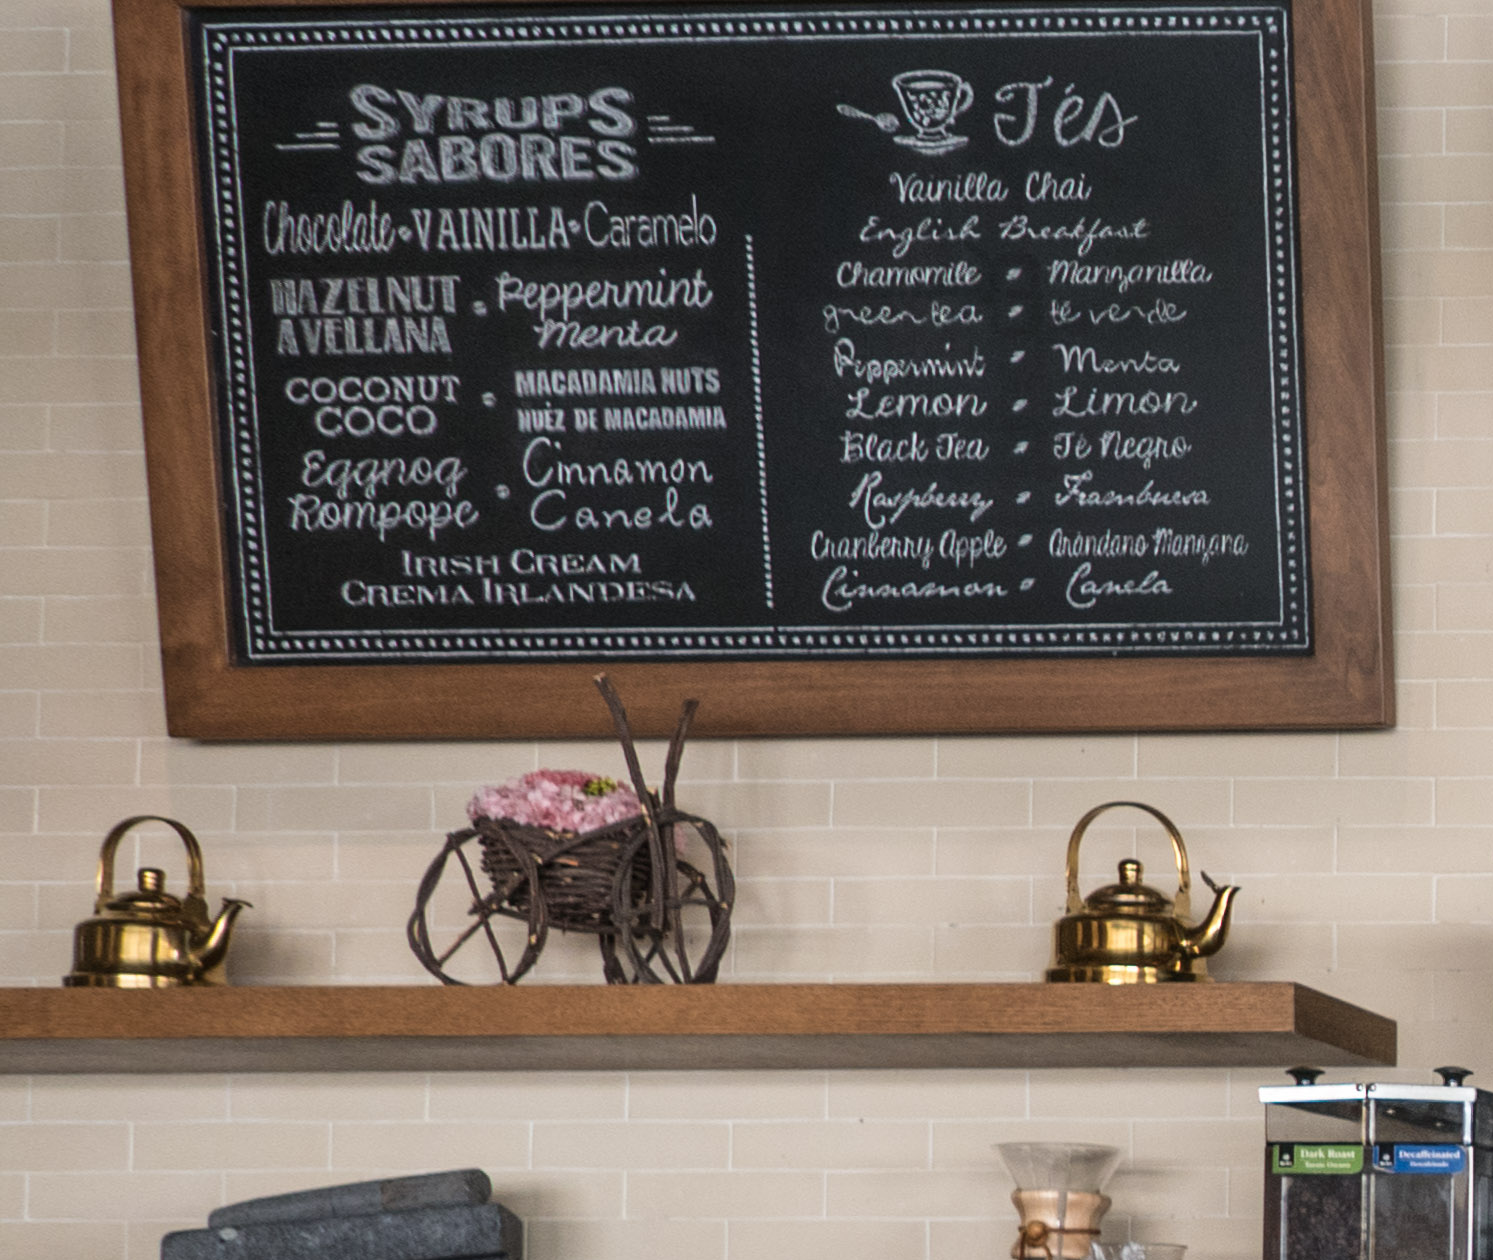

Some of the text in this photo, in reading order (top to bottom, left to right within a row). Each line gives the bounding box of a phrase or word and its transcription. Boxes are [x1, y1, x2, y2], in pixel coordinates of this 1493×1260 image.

[349, 83, 638, 141] SYRUPS
[355, 133, 640, 184] SABORES
[890, 171, 1092, 204] Vainilla Chai
[263, 193, 717, 256] Chocolate VAINILLA Caramelo
[859, 215, 1150, 258] English Breakfast
[269, 274, 460, 315] HAZELNUT
[494, 267, 713, 321] Peppermint
[836, 259, 1213, 293] Chamomile Manzanilla
[276, 316, 452, 356] AVELLANA
[534, 319, 678, 350] Menta
[822, 305, 927, 334] green
[931, 301, 983, 326] tea
[1090, 298, 1188, 326] verde
[833, 338, 1181, 383] Peppermint Menta
[285, 375, 460, 404] COCONUT
[514, 367, 720, 397] MACADAMIA NUTS
[314, 405, 438, 437] COCO
[574, 408, 599, 432] DE
[604, 406, 727, 431] MACADAMIA
[845, 387, 988, 420] Lemon
[523, 436, 714, 487] Cinnamon
[839, 430, 929, 464] Black
[936, 432, 990, 462] Tea
[1099, 430, 1192, 470] Negro
[302, 449, 468, 498] Eggnog
[1054, 470, 1211, 506] Frambuesa
[287, 492, 480, 541] Rompope
[530, 486, 714, 531] Canela
[810, 529, 935, 570] Cranberry
[939, 528, 1007, 569] Apple
[1151, 527, 1250, 567] Manzana
[821, 561, 1174, 613] Cinnamon Canela
[1301, 1148, 1355, 1159] Dark Roast
[1399, 1149, 1460, 1160] Decaffeinated
